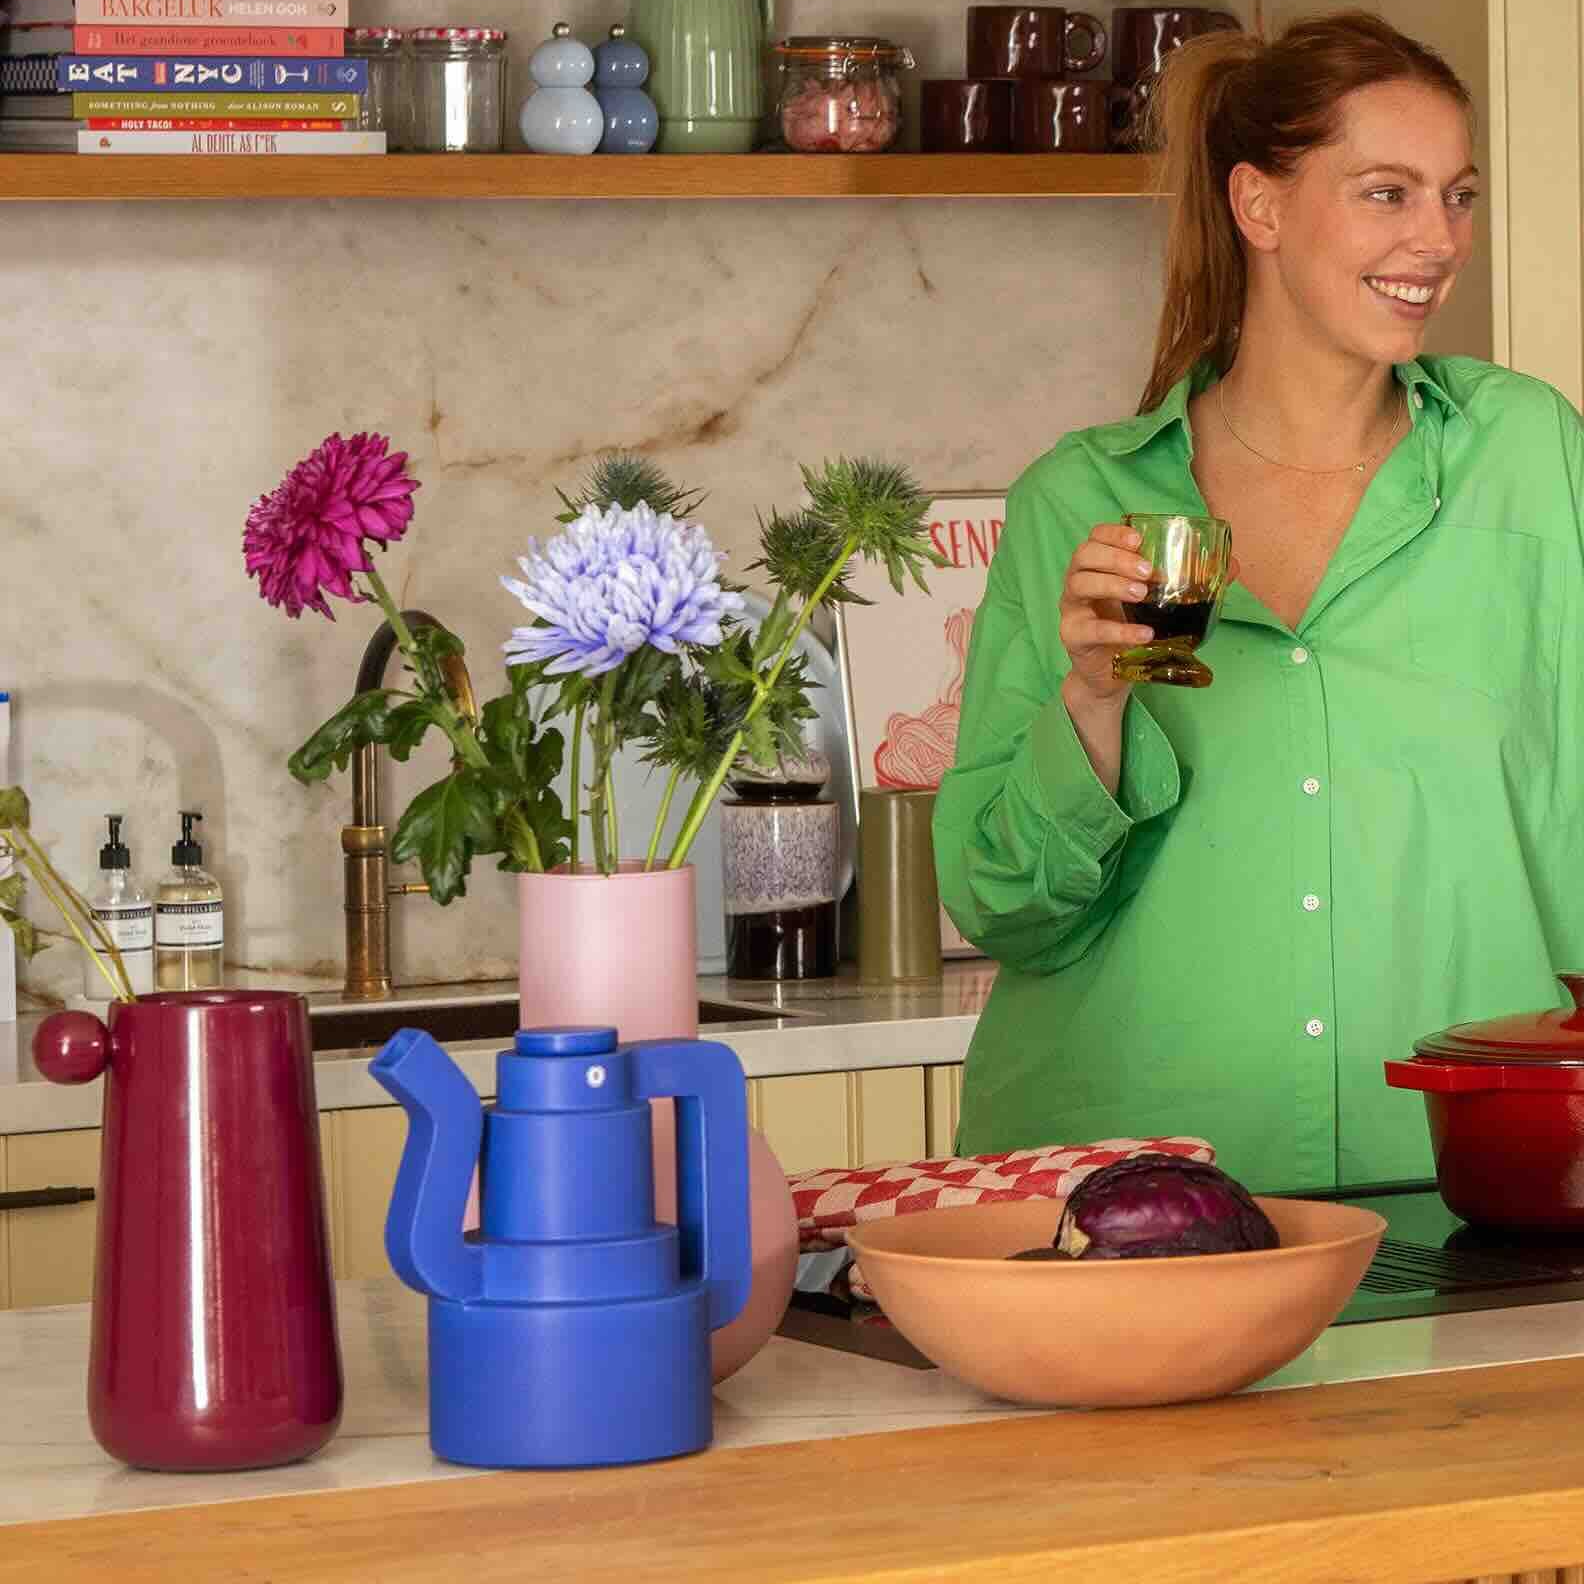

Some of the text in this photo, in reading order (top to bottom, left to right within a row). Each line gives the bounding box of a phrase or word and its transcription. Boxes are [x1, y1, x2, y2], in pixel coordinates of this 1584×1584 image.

[102, 0, 223, 17] BAKGELUK
[228, 2, 273, 16] HELEN
[68, 62, 137, 84] EAT
[174, 63, 242, 85] NYC
[88, 101, 147, 110] SOMETHING
[121, 119, 145, 129] HOLY
